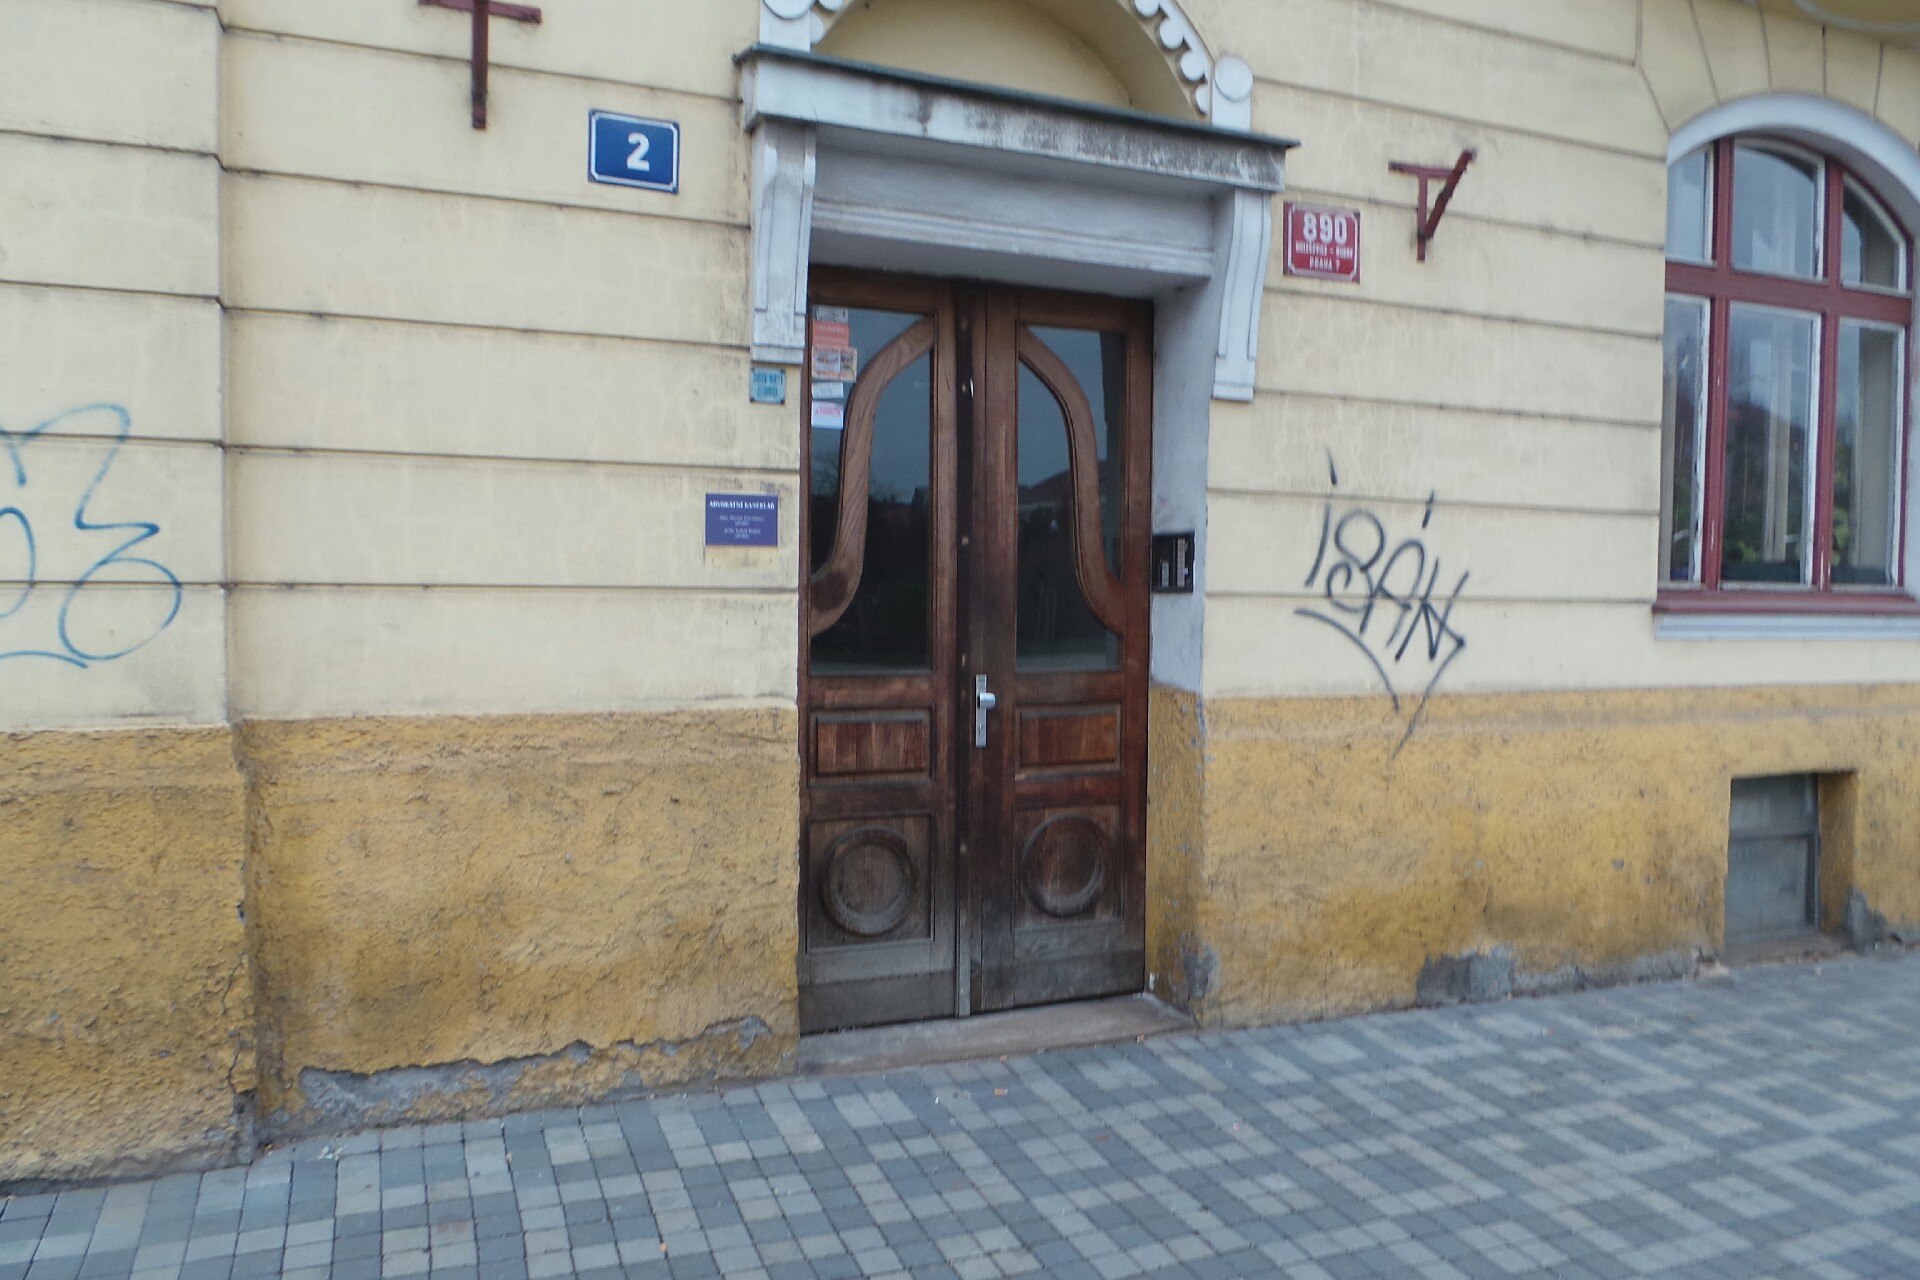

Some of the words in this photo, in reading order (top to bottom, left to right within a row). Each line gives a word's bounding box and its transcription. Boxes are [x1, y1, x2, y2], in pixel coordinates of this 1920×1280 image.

[627, 132, 650, 172] 2
[1303, 212, 1347, 245] 890
[1309, 256, 1333, 271] PRAHA
[1335, 259, 1341, 272] 7
